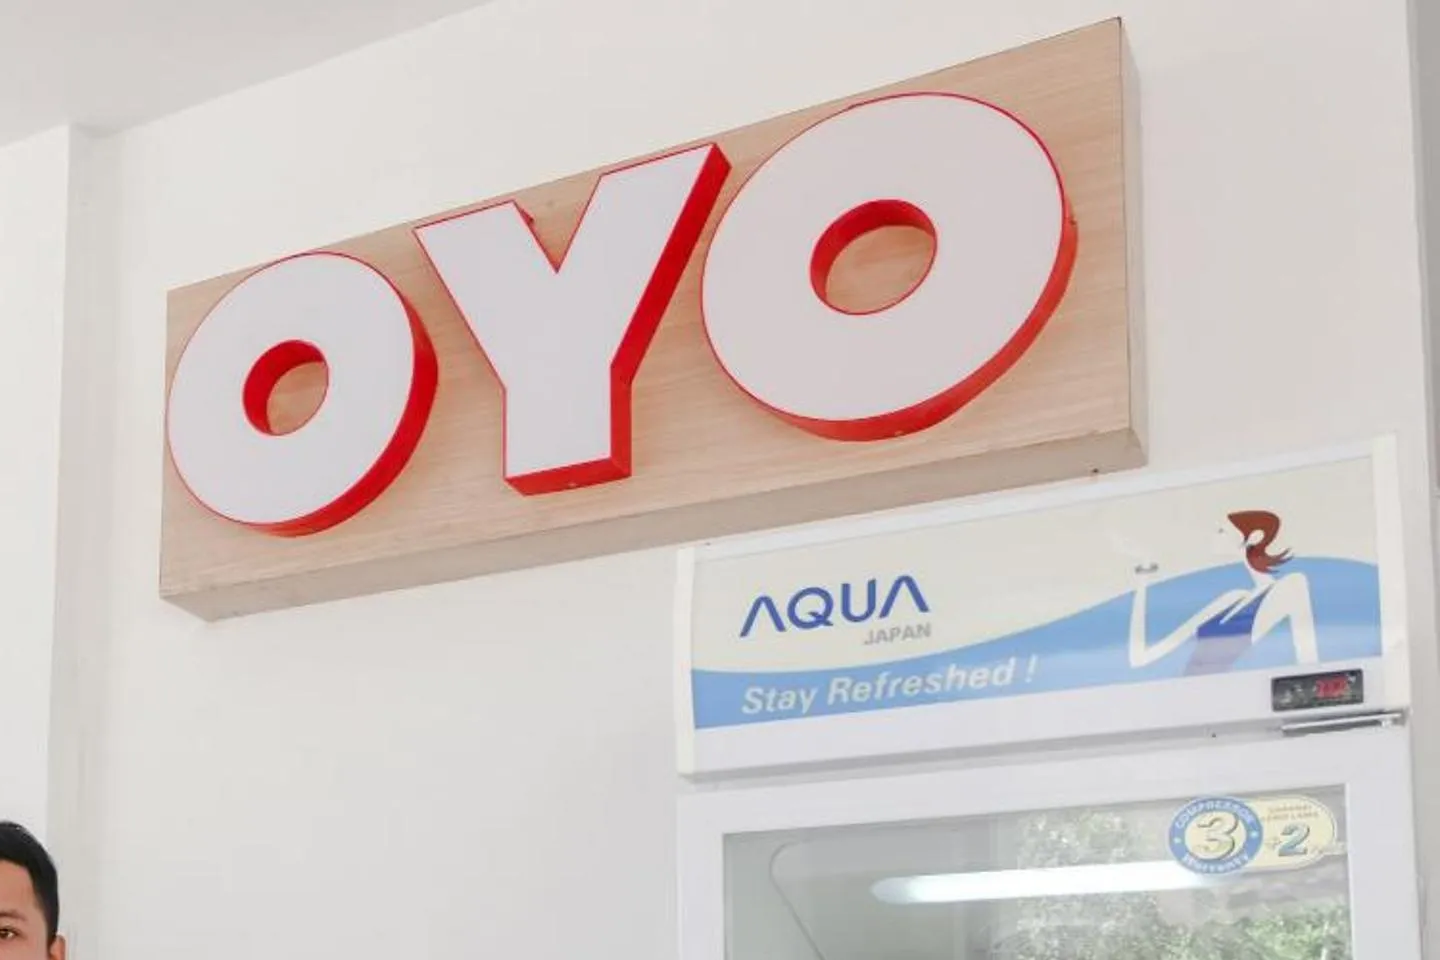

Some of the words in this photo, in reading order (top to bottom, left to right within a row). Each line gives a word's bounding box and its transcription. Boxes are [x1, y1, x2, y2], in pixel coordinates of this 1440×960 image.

[166, 92, 1078, 537] OYO
[739, 574, 931, 638] AQUA
[863, 622, 932, 646] JAPAN
[741, 685, 818, 715] Stay
[827, 656, 1017, 706] Refreshed
[1194, 812, 1240, 858] 3
[1278, 822, 1311, 857] 2
